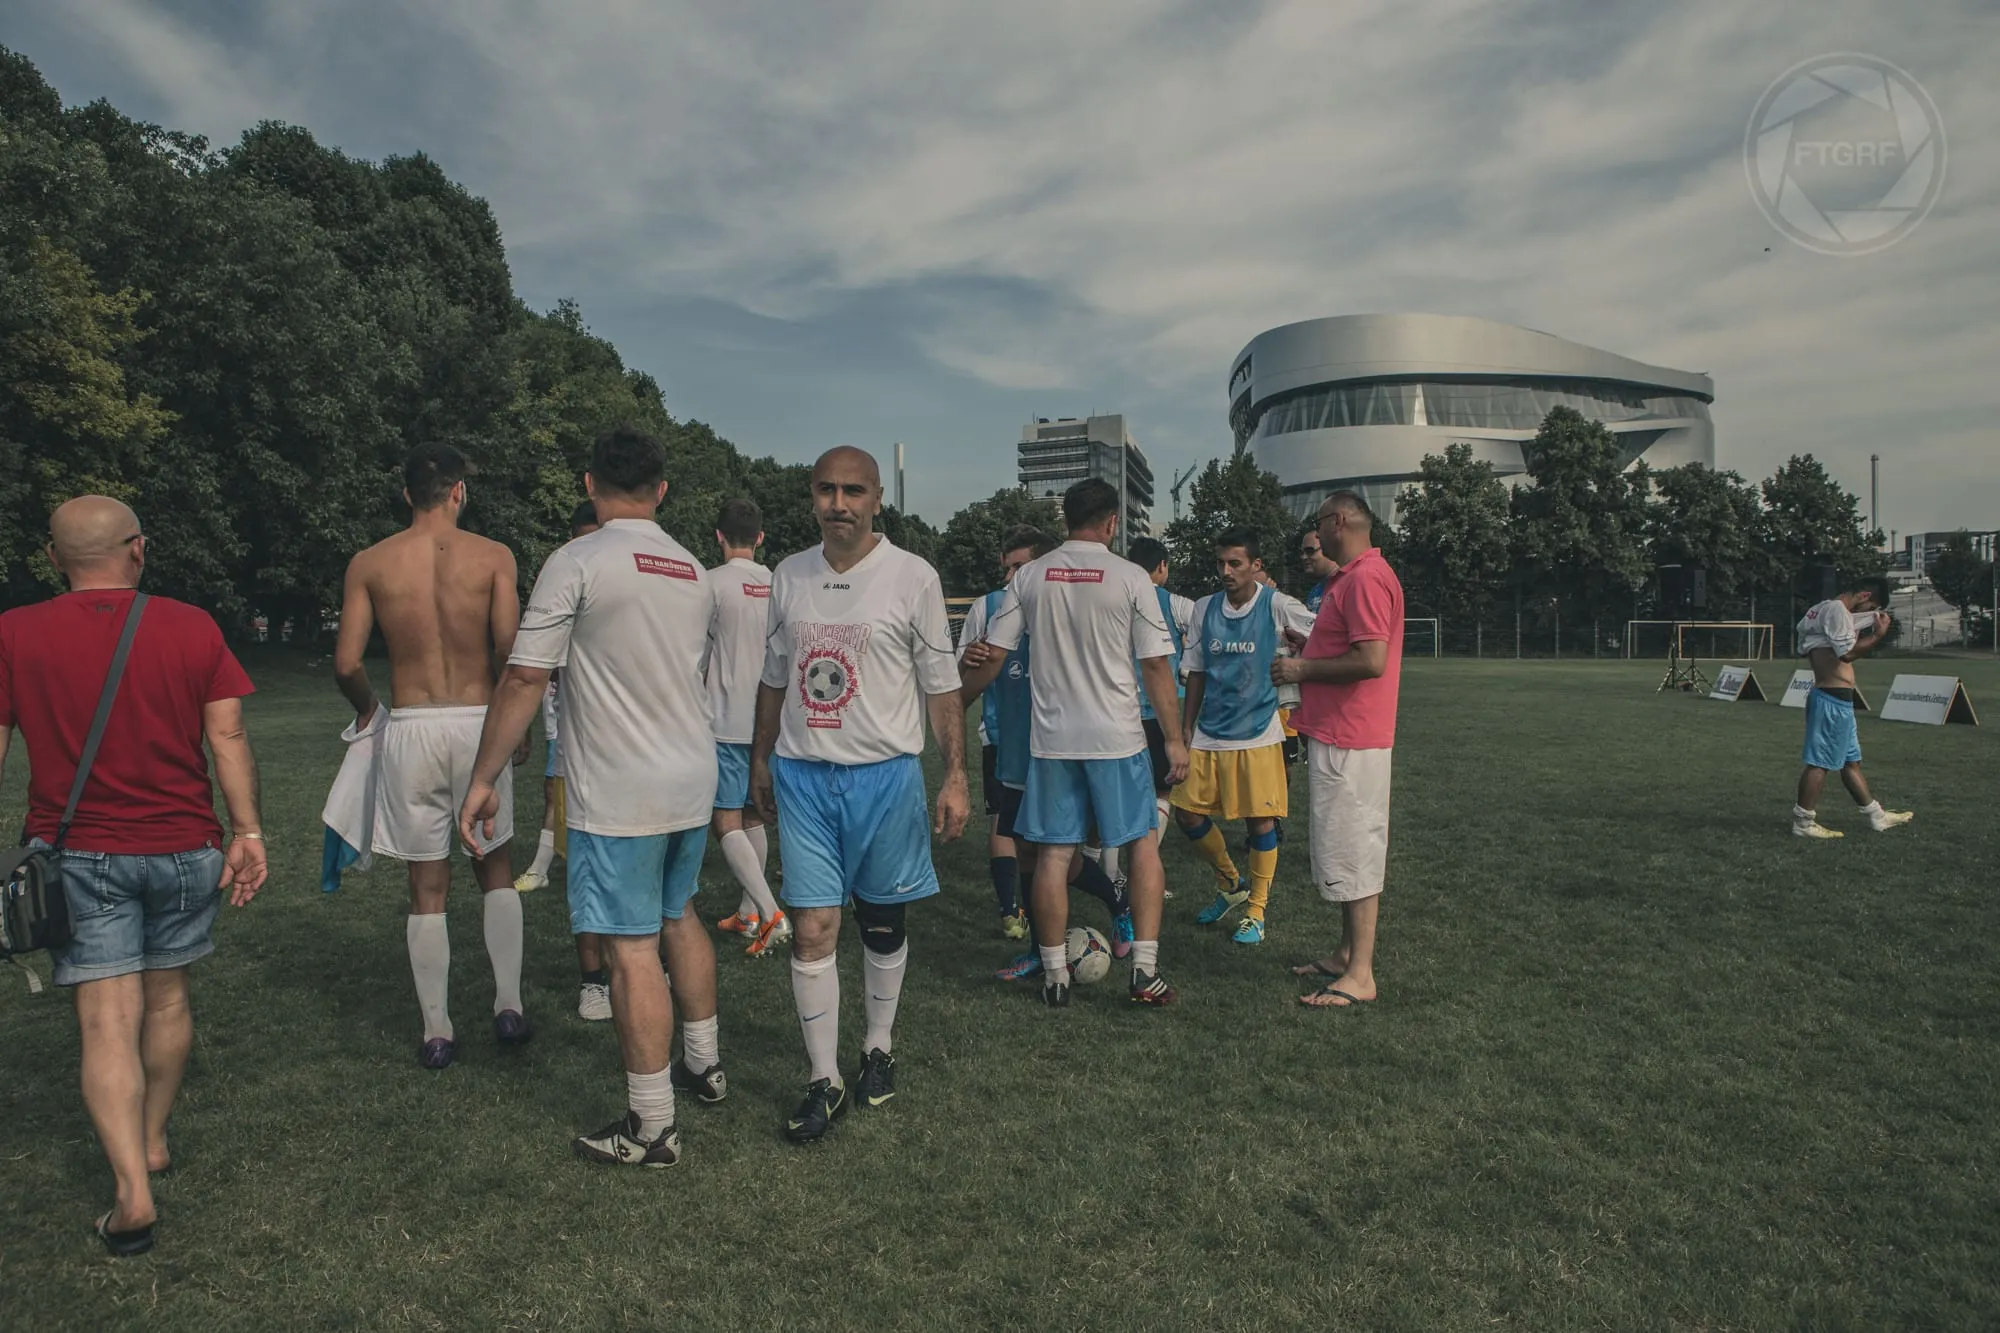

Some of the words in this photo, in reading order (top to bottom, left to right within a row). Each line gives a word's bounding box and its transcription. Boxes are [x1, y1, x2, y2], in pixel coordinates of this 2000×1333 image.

[639, 557, 654, 565] DAS
[654, 560, 693, 572] HANDWERK
[832, 583, 850, 591] JAKO
[792, 621, 873, 655] HANDWERKER
[1225, 641, 1256, 654] JAKO
